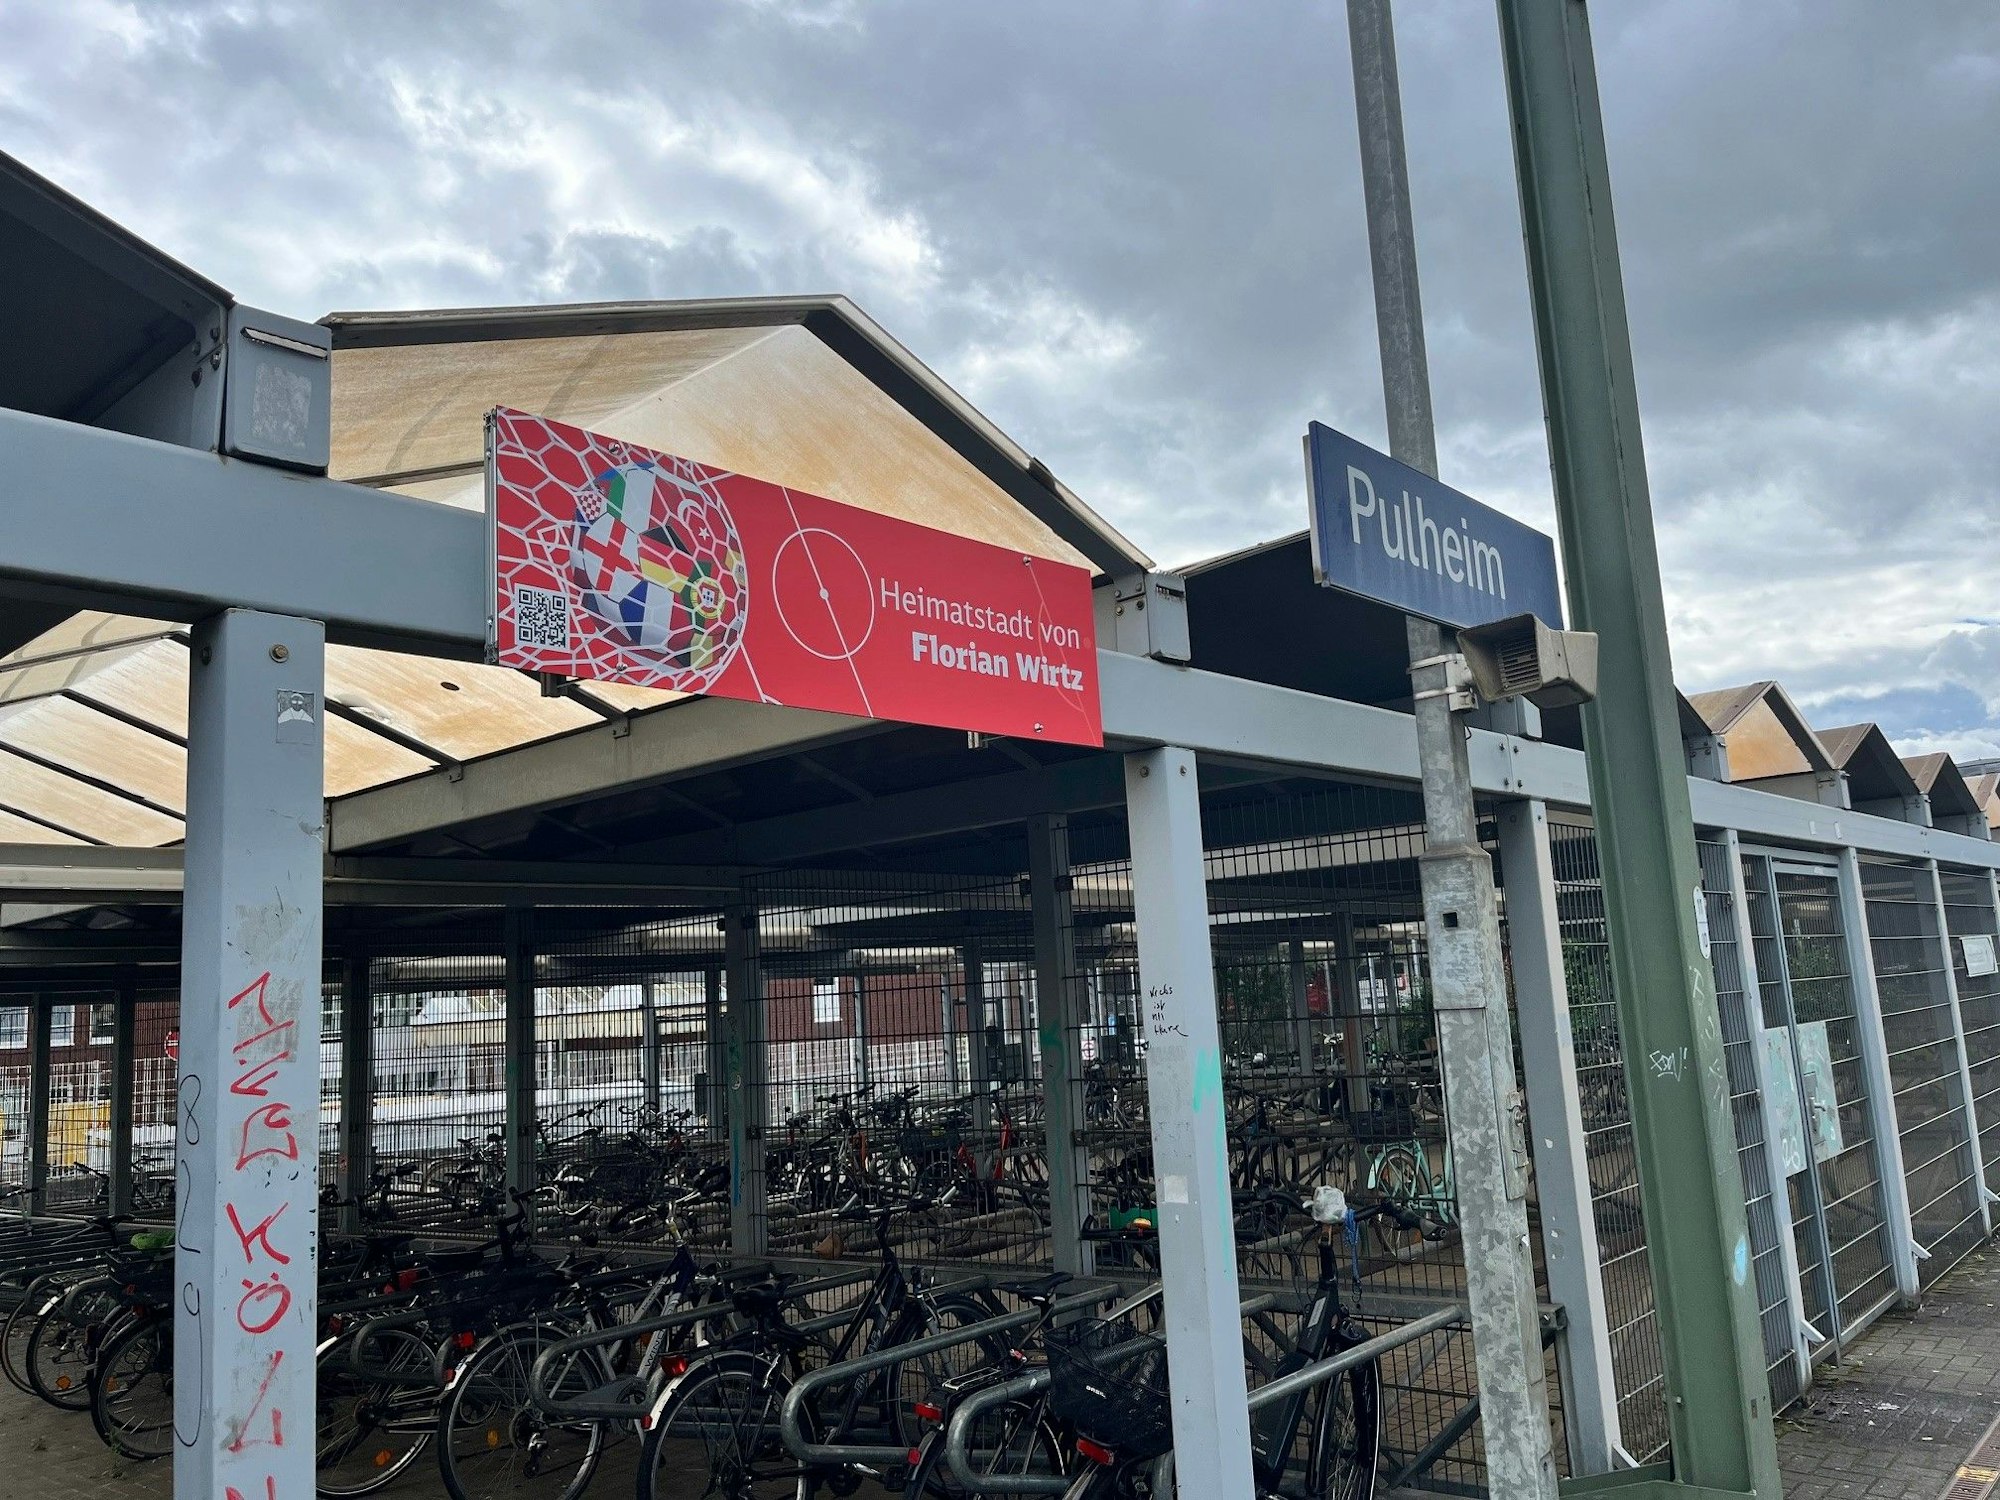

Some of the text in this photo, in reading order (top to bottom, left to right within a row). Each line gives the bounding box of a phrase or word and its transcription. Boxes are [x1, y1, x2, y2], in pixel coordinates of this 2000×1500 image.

[1346, 464, 1506, 600] Pulheim
[880, 577, 1080, 650] Heimatstadt von
[911, 631, 1084, 691] Florian Wirtz
